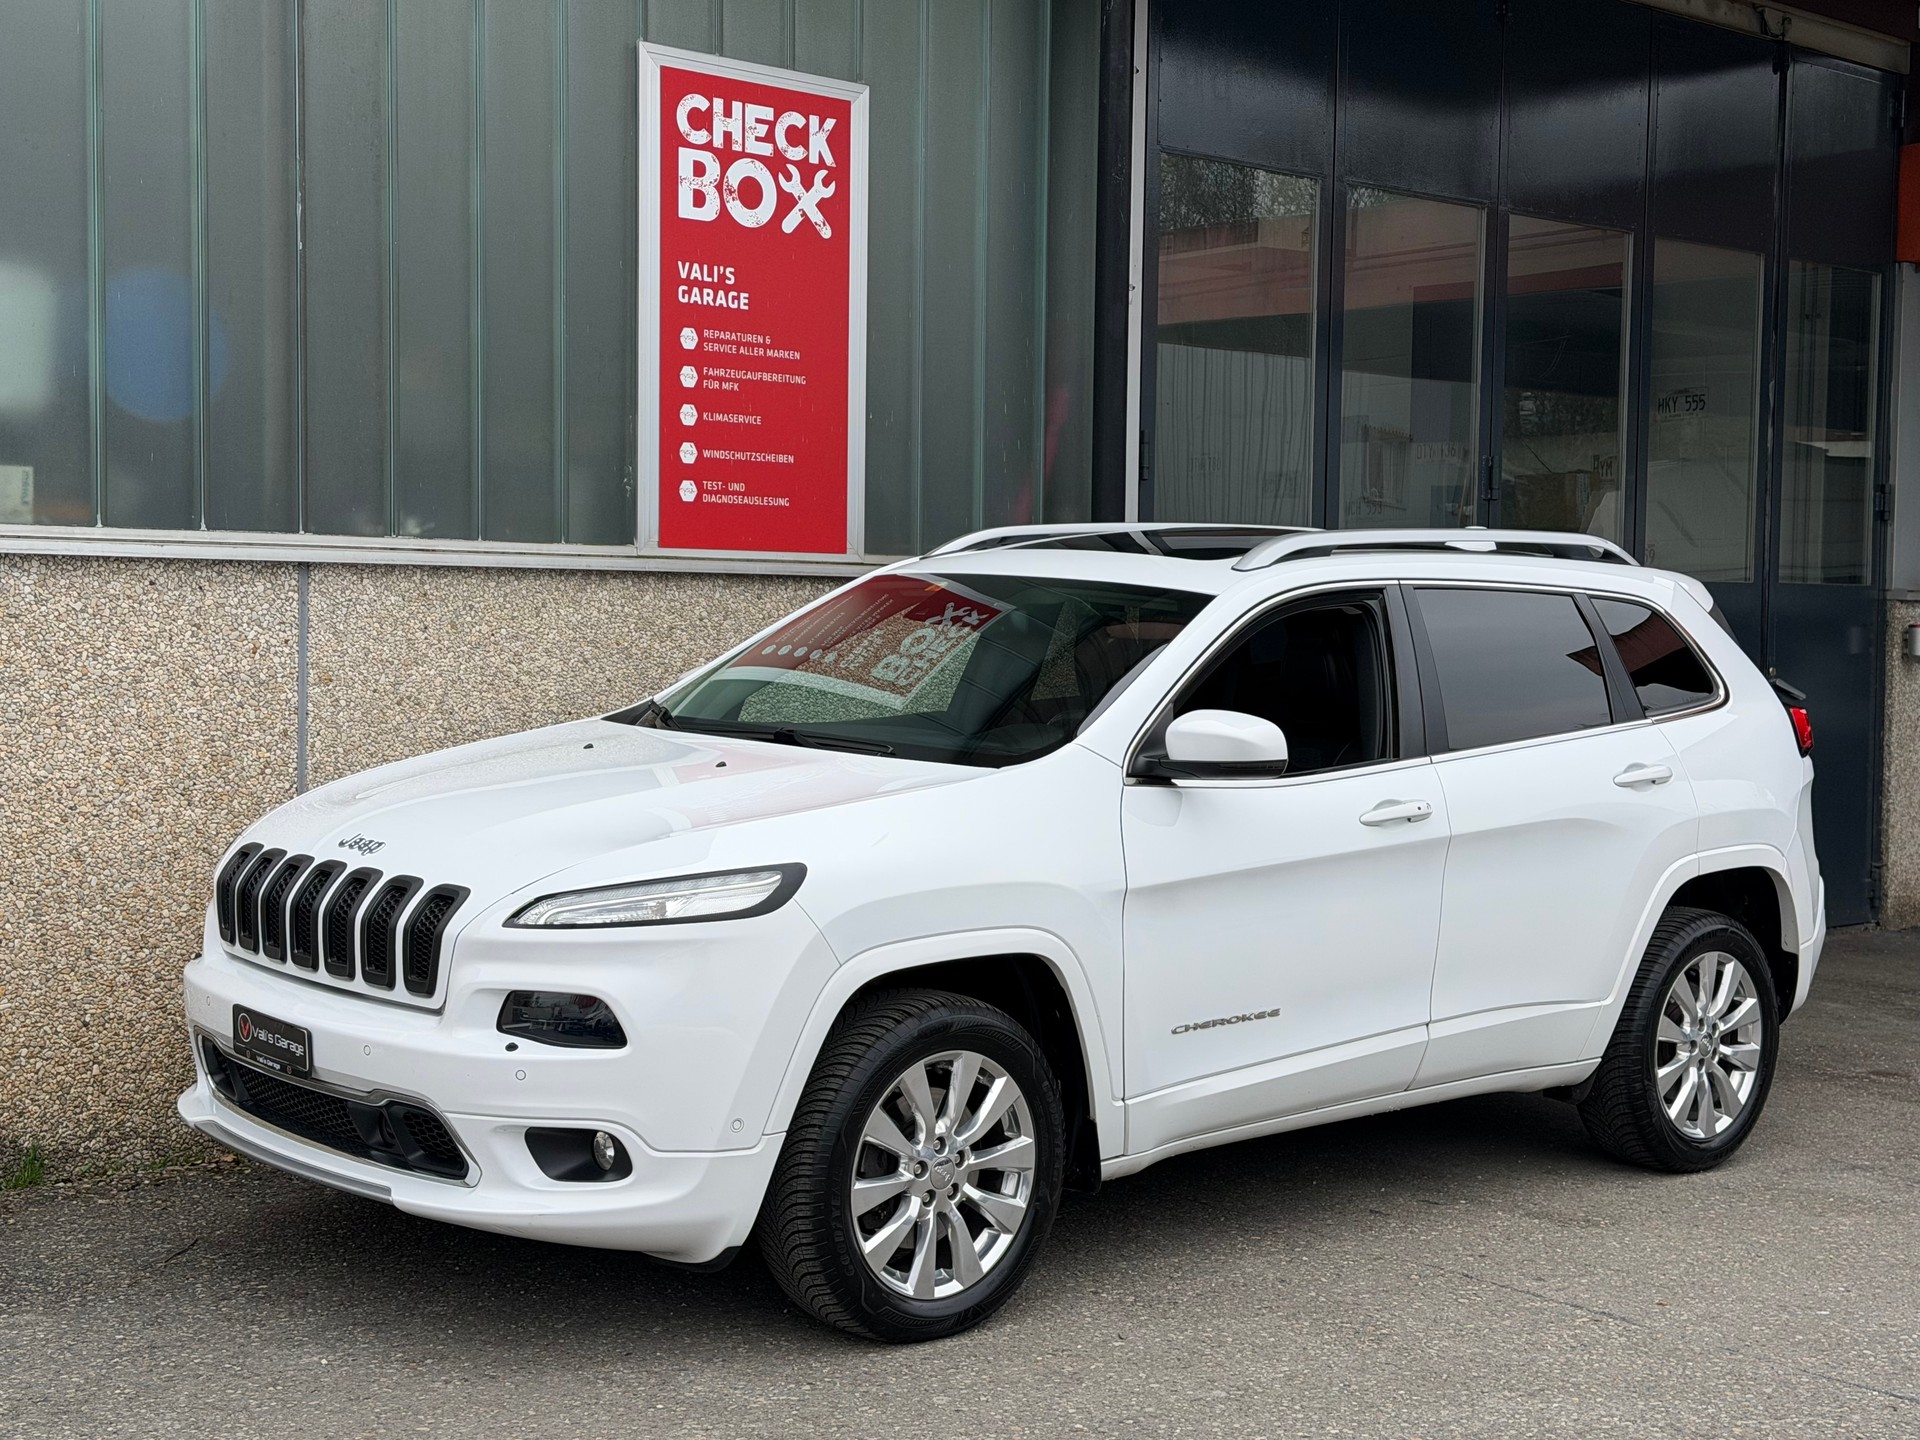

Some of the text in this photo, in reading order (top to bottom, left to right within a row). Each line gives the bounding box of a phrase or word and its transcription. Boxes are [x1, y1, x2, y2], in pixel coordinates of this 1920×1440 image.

[676, 93, 837, 167] CHECK
[678, 147, 836, 239] BOX
[678, 260, 735, 284] VALI'S
[678, 285, 749, 310] GARAGE
[703, 329, 771, 344] REPARATUREN &
[703, 342, 800, 360] SERVICE ALLER MARKEN
[703, 367, 806, 385] FAHRZEUGAUFBEREITUNG
[703, 379, 739, 391] FÜR MFK
[1685, 394, 1706, 411] 555
[703, 411, 762, 425] KLIMASERVICE
[702, 449, 794, 464] WINDSCHUTZSCHEIBEN
[702, 480, 745, 492] TEST- UND
[702, 493, 790, 507] DIAGNOSEAUSLESUNG
[338, 833, 386, 856] Jeep
[1171, 1008, 1281, 1034] CHEROKEE
[274, 1033, 305, 1057] Garage
